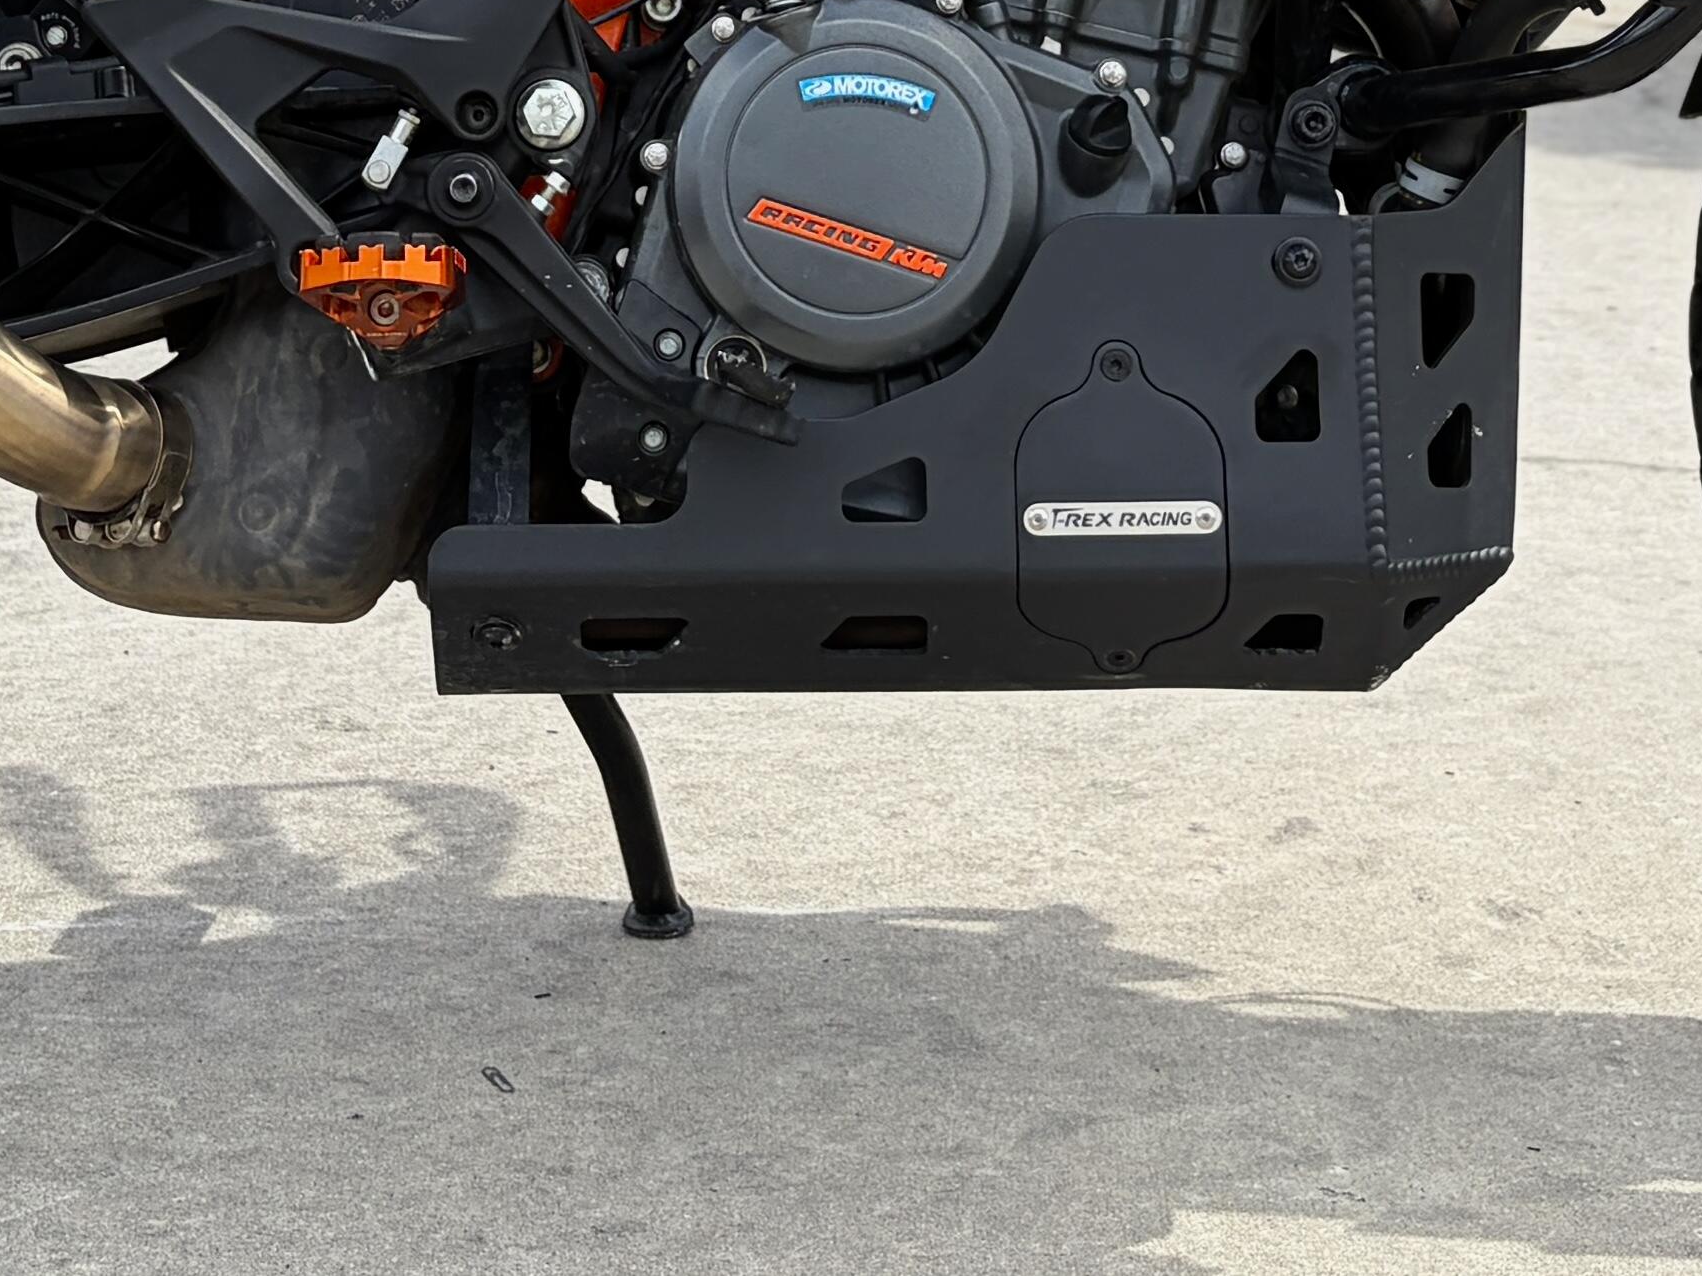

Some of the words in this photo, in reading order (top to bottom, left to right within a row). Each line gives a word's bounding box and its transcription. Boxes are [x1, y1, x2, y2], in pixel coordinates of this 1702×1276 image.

[833, 75, 931, 111] MOTOREX
[760, 206, 881, 252] RACING
[888, 245, 948, 279] KTM
[1052, 508, 1113, 529] T-REX
[1119, 511, 1192, 528] RACING
